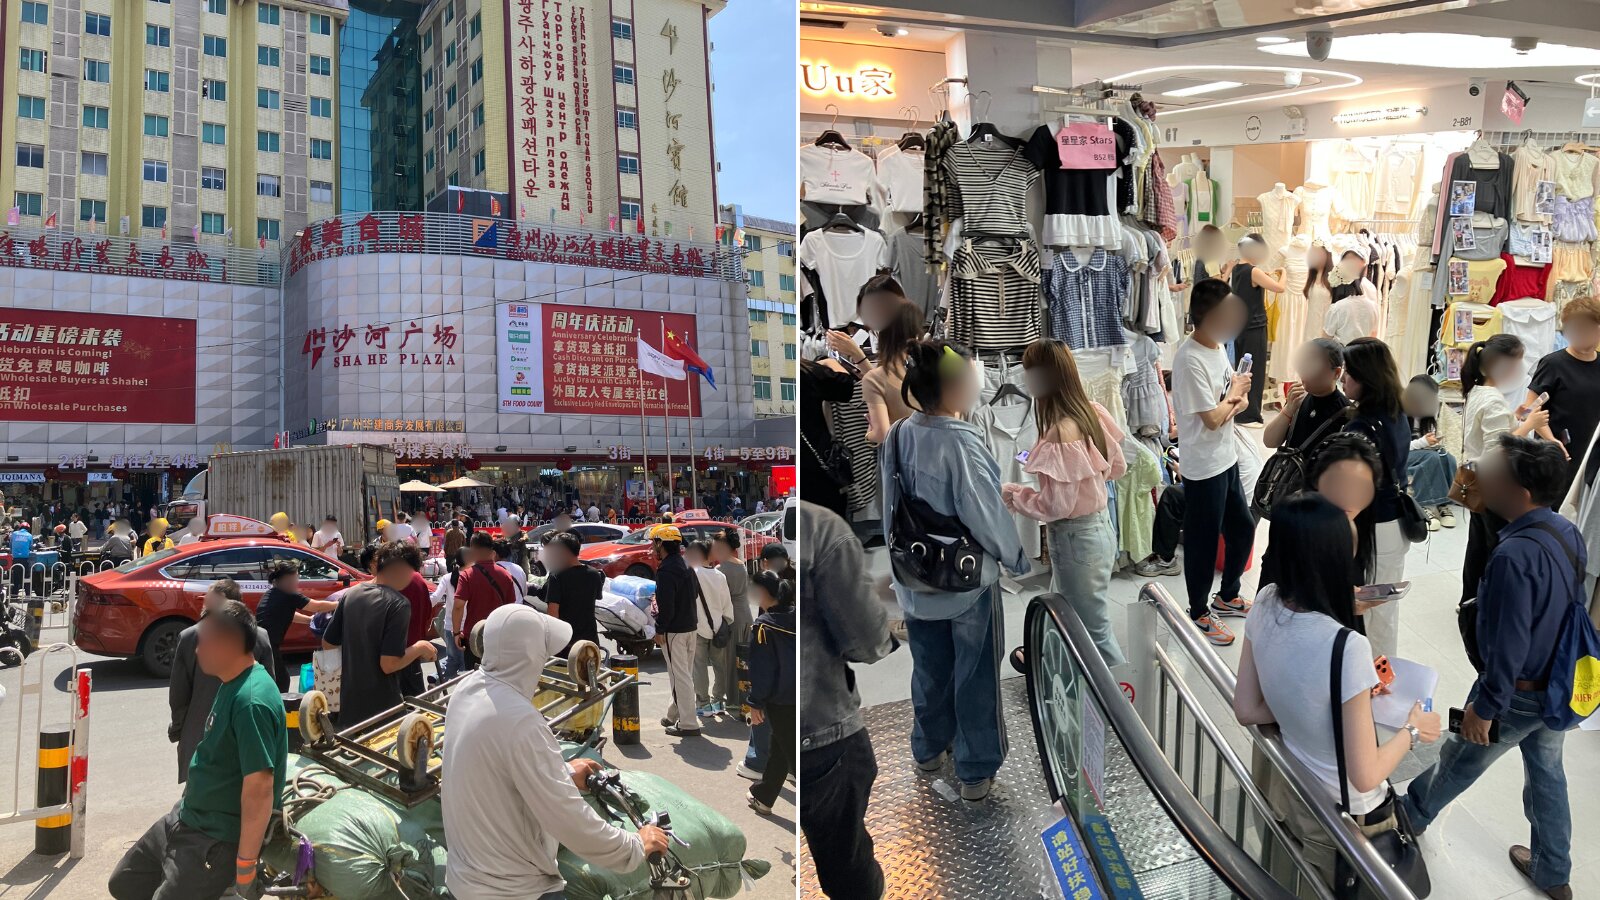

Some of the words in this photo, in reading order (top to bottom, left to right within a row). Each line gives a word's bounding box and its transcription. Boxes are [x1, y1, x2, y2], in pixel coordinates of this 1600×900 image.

[554, 1, 565, 82] Торговый
[558, 91, 567, 142] центр
[1090, 135, 1113, 145] Stars
[560, 151, 570, 211] одежды
[551, 311, 634, 334] 周年庆活动
[332, 321, 458, 353] 沙河广场
[552, 331, 596, 341] Anniversary
[597, 333, 638, 342] Celebration
[56, 346, 66, 356] is
[68, 348, 112, 359] Coming!
[553, 340, 626, 356] 拿货现金抵扣
[399, 353, 456, 365] PLAZA
[571, 355, 604, 363] Discount
[1, 373, 58, 383] Wholesale
[60, 376, 97, 386] Buyers
[99, 376, 110, 385] at
[111, 377, 149, 386] Shahe!
[554, 376, 574, 384] Lucky
[577, 376, 596, 384] Draw
[13, 402, 70, 411] Wholesale
[72, 403, 128, 412] Purchases
[394, 442, 474, 459] 5楼美食城
[608, 445, 631, 460] 3街
[704, 447, 725, 461] 4街
[740, 446, 790, 461] 5至9街
[57, 454, 87, 469] 2街
[109, 453, 199, 469] 通往2至4楼
[0, 473, 42, 481] IQIMANA
